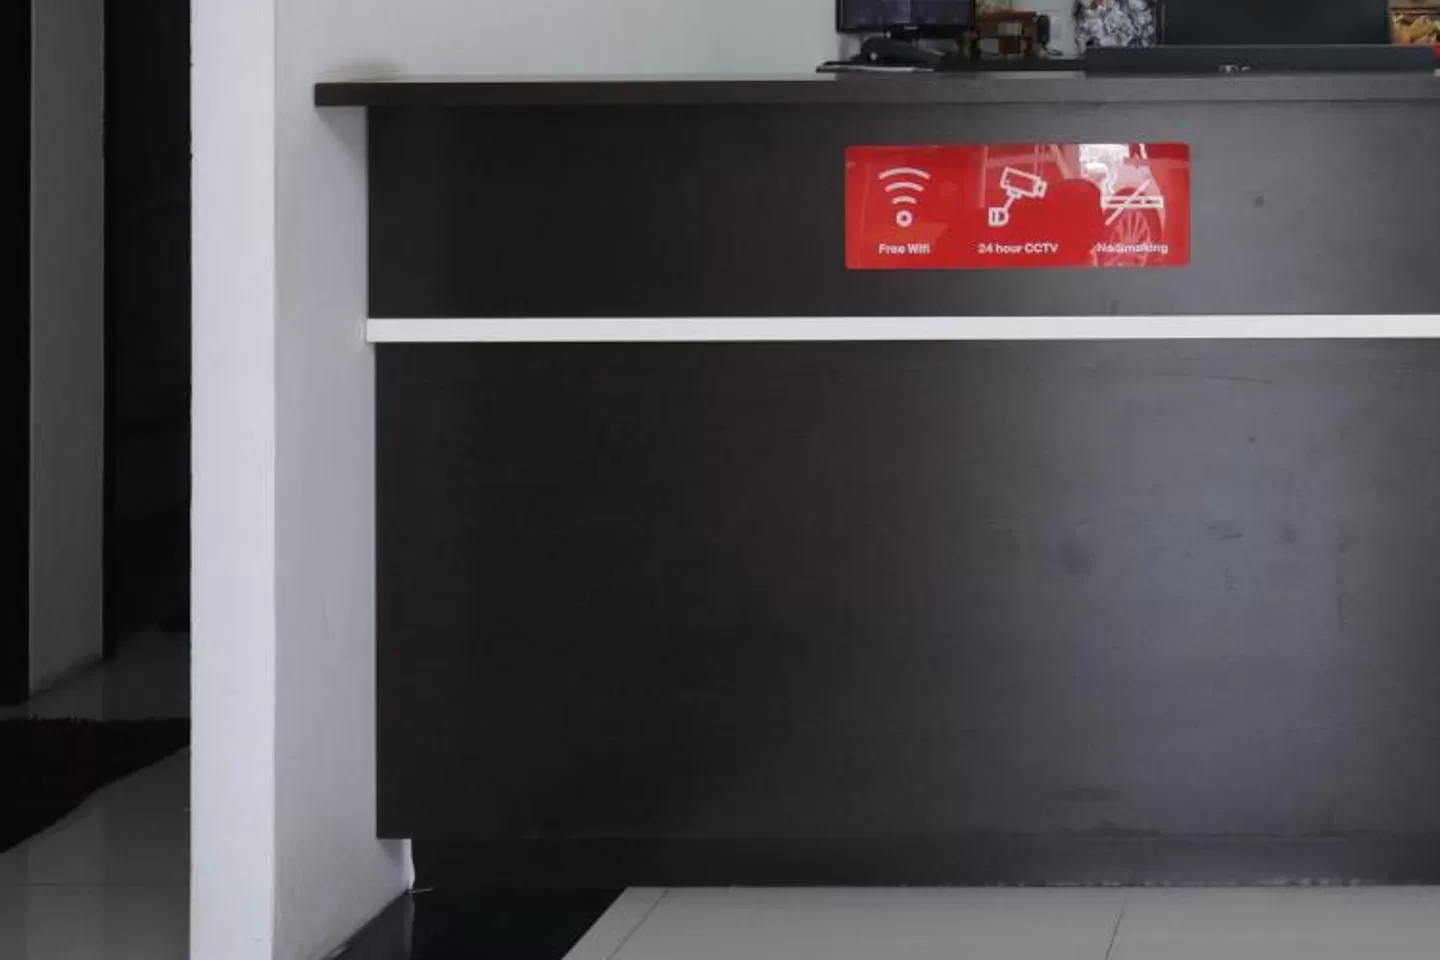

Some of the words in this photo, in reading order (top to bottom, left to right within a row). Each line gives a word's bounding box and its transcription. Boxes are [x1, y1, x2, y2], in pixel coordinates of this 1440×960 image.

[878, 243, 906, 254] Free
[977, 242, 994, 254] 24
[995, 242, 1022, 254] hour
[1024, 242, 1059, 254] CCTV
